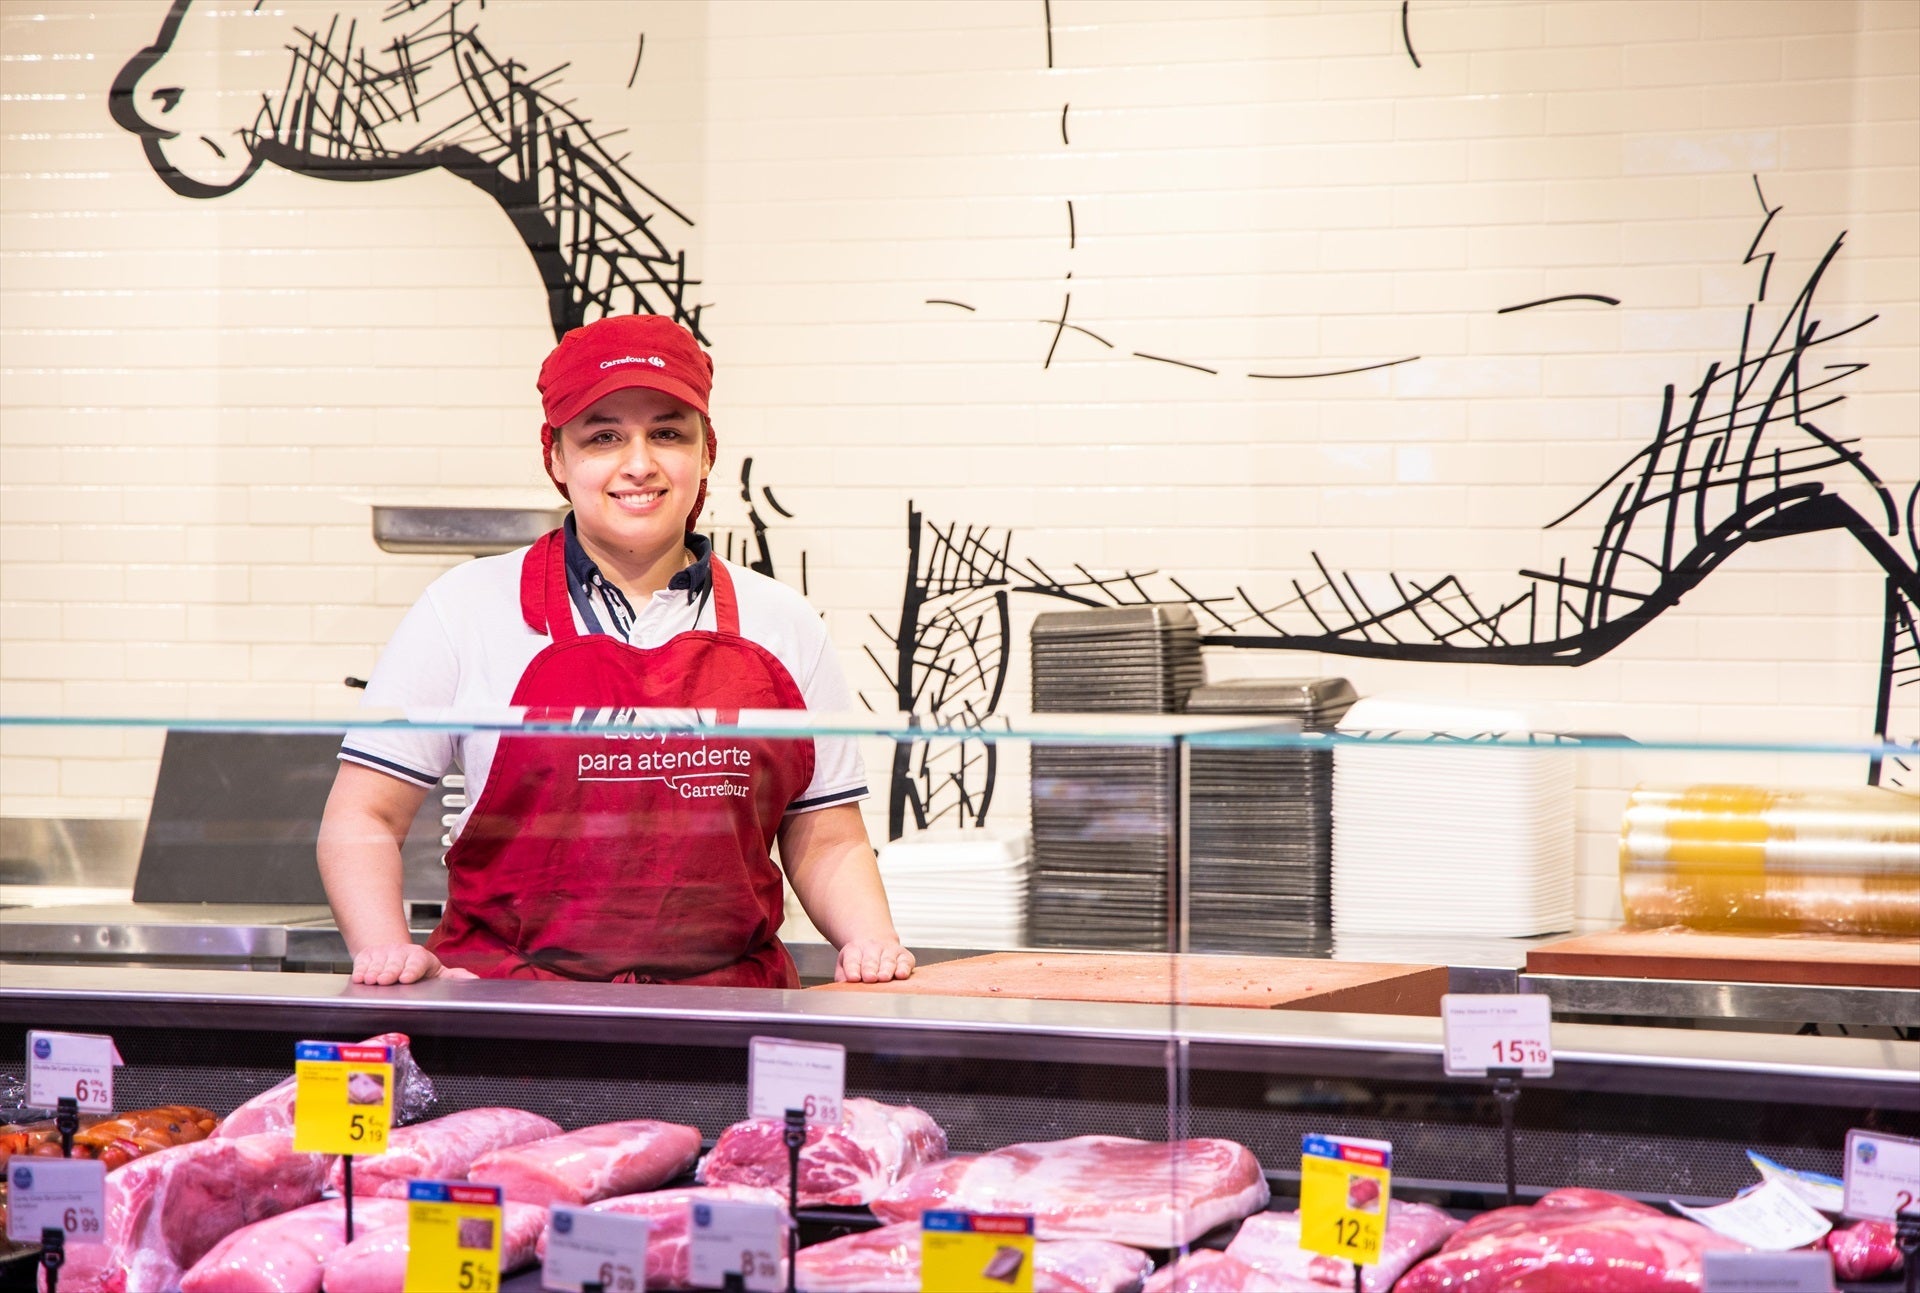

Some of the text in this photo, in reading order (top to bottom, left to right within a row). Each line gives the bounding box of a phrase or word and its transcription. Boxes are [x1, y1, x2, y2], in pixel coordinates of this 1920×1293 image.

[600, 356, 646, 369] Carrefour
[578, 746, 751, 776] para atenderte
[680, 780, 749, 799] Carrefour
[1492, 1040, 1524, 1063] 15
[76, 1079, 108, 1103] 6 75
[803, 1094, 816, 1118] 6
[350, 1115, 364, 1141] 5
[63, 1208, 99, 1233] 6 99
[1335, 1217, 1358, 1248] 12
[458, 1260, 474, 1290] 5
[599, 1262, 614, 1288] 6
